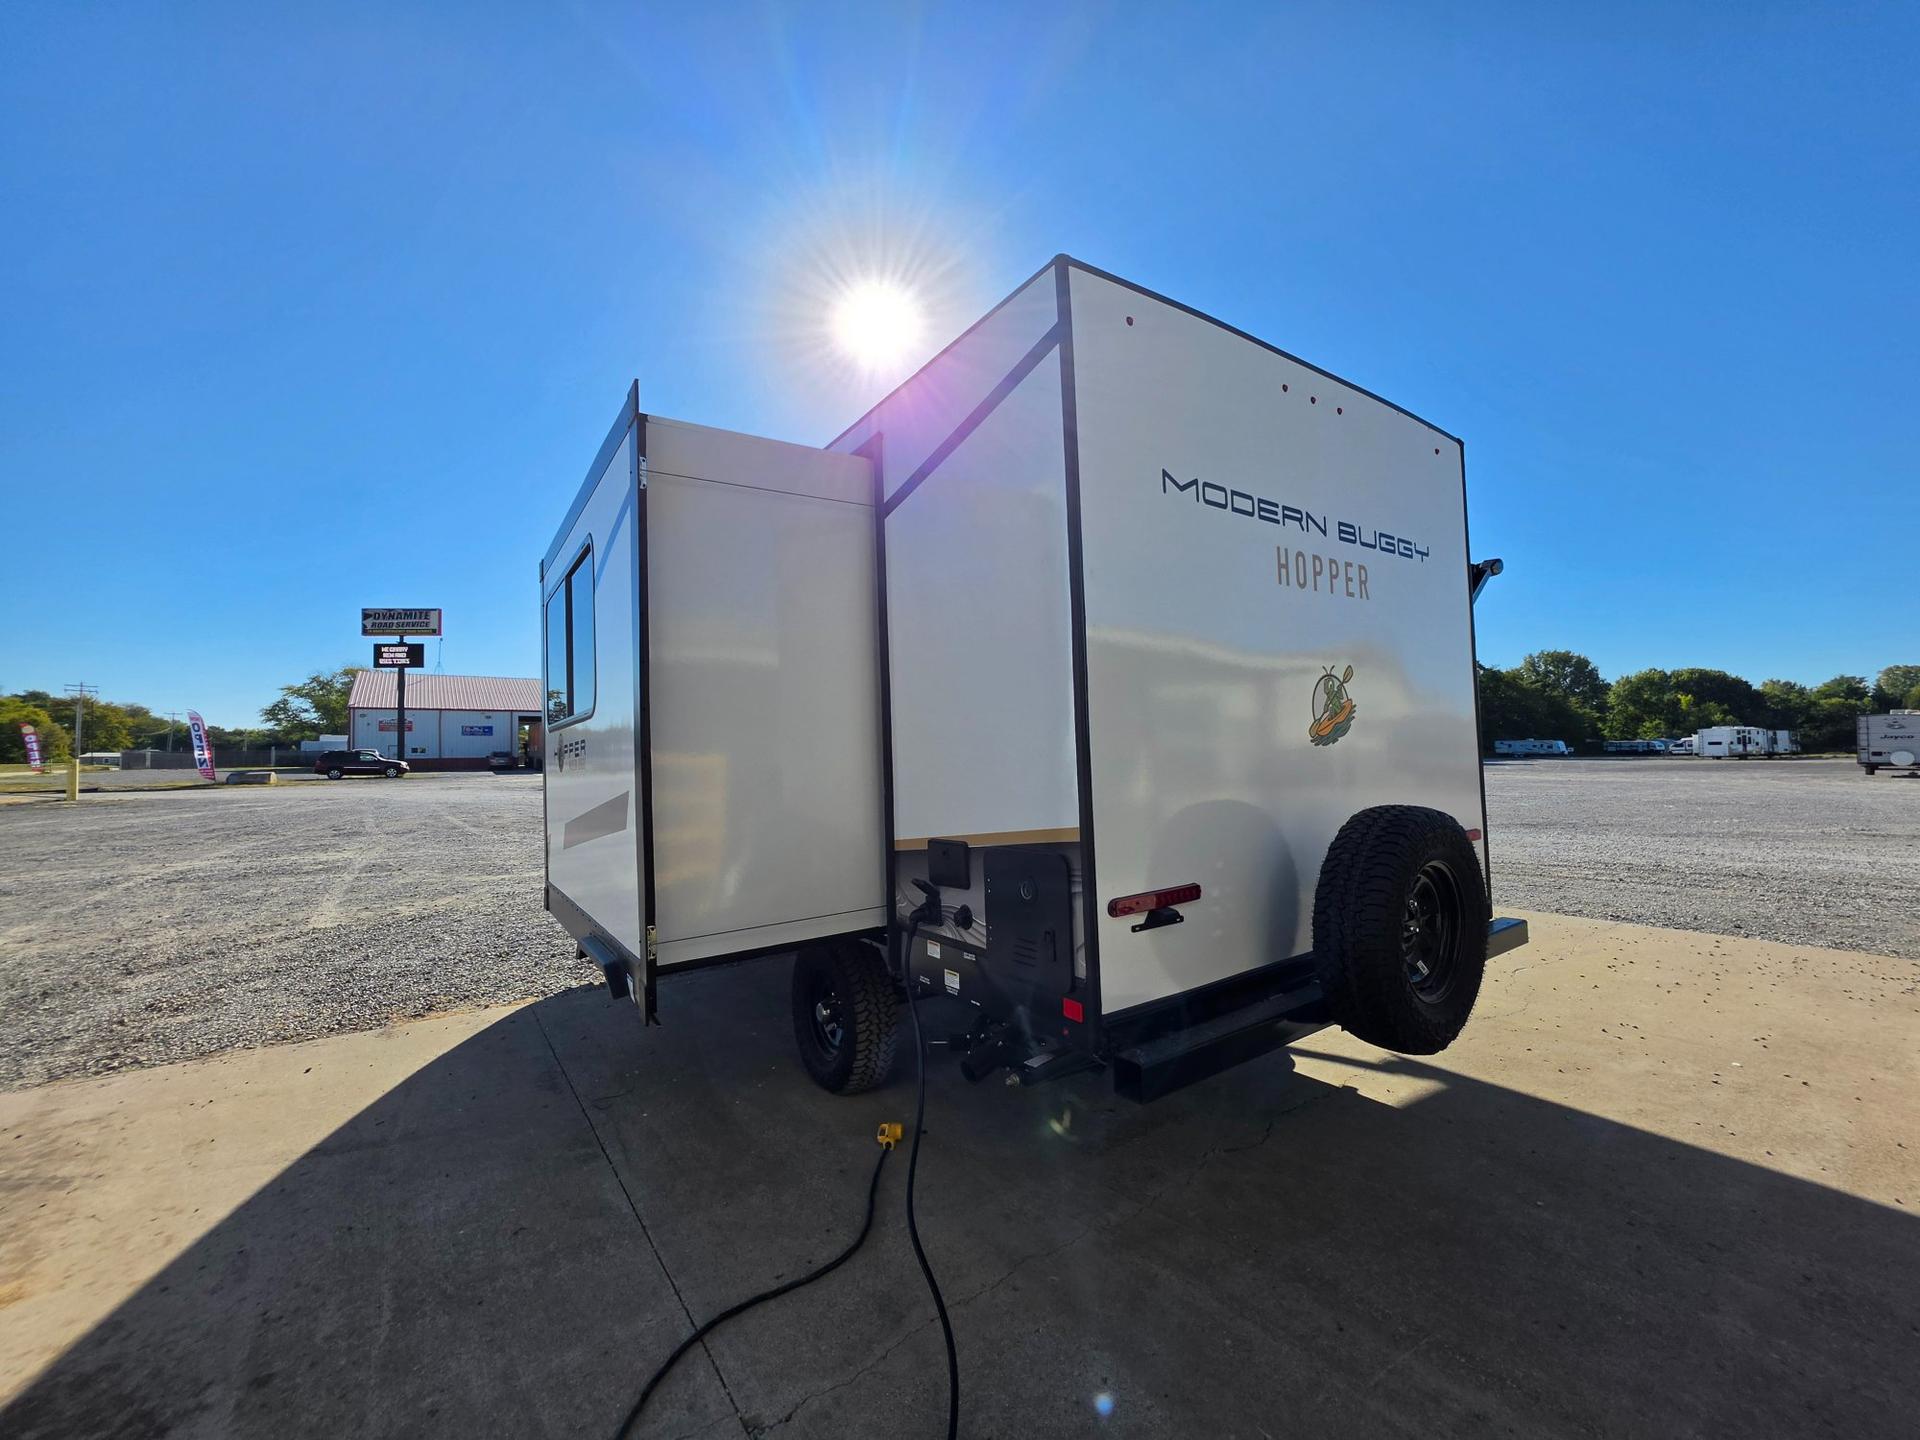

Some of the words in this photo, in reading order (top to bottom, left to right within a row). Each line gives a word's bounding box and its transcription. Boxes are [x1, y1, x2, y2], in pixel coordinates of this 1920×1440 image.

[1161, 467, 1328, 538] MODERN
[1337, 520, 1430, 563] BUGGY
[1276, 545, 1370, 600] HOPPER
[373, 611, 430, 620] DYNAMITE
